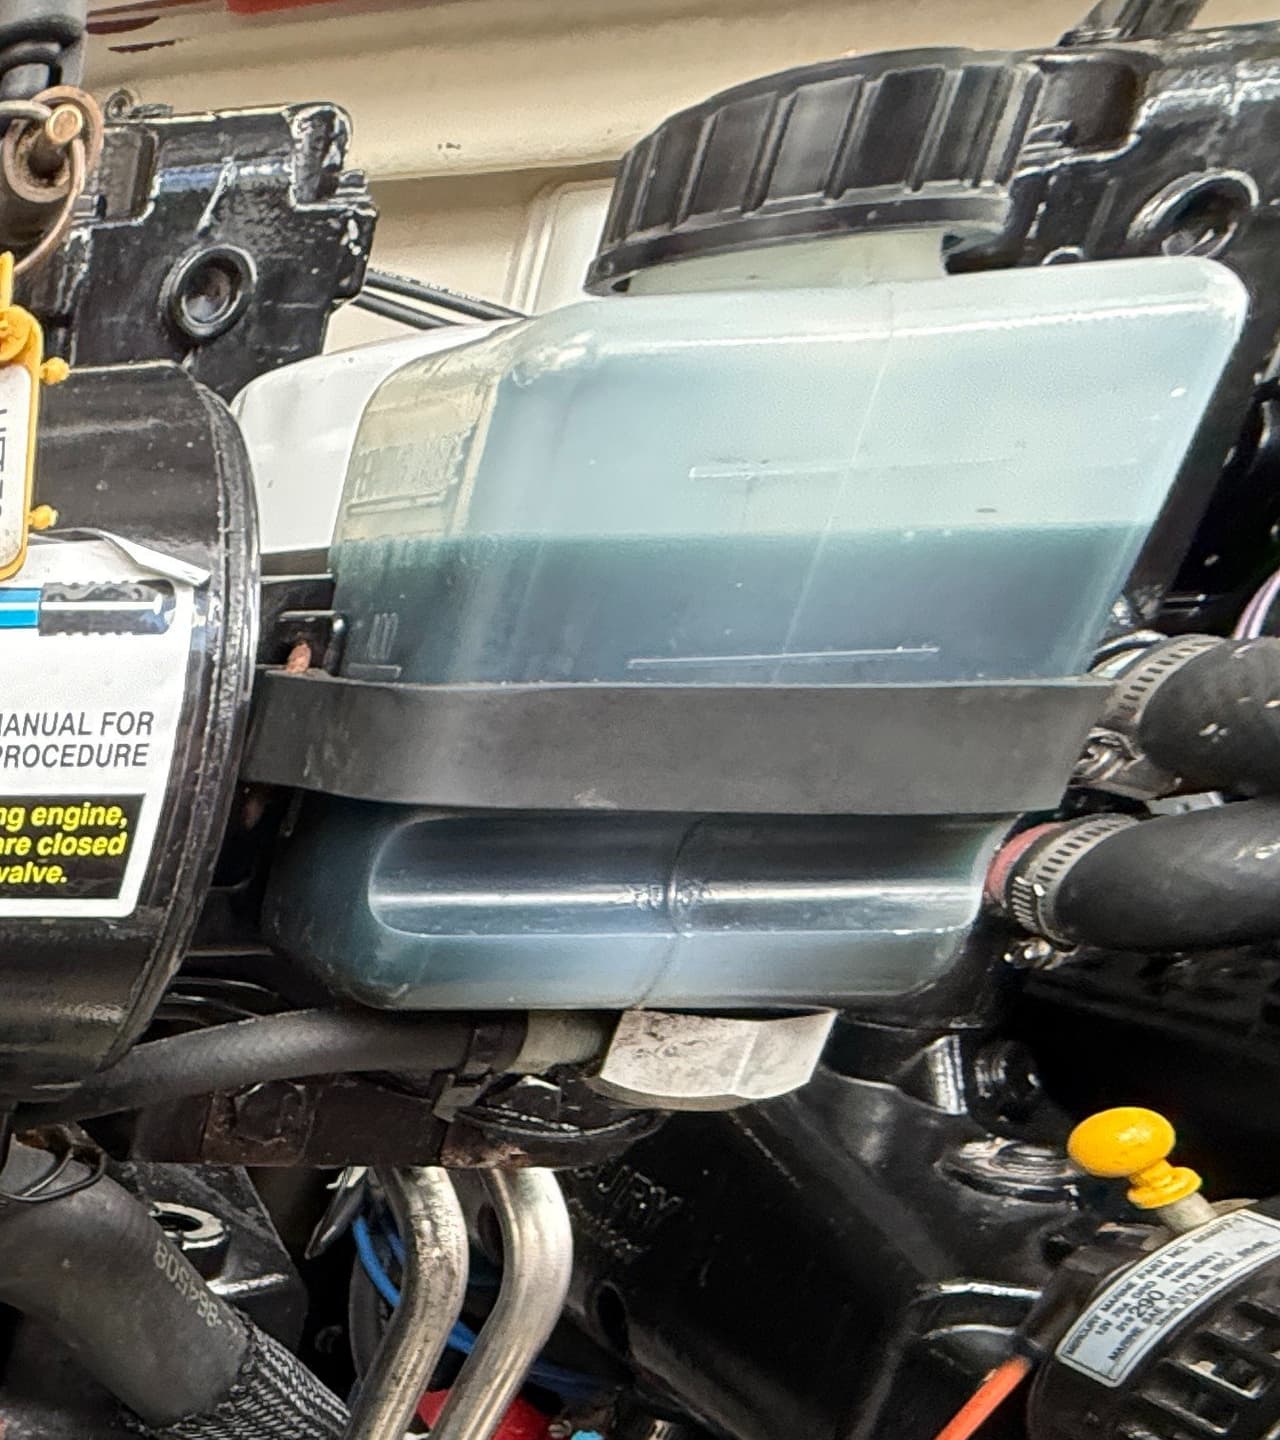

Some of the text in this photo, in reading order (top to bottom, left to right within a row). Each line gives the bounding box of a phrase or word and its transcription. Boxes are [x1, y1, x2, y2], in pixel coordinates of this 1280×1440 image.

[100, 710, 155, 736] FOR
[30, 801, 129, 831] engine,
[36, 831, 128, 857] closed
[1127, 1290, 1165, 1318] 290
